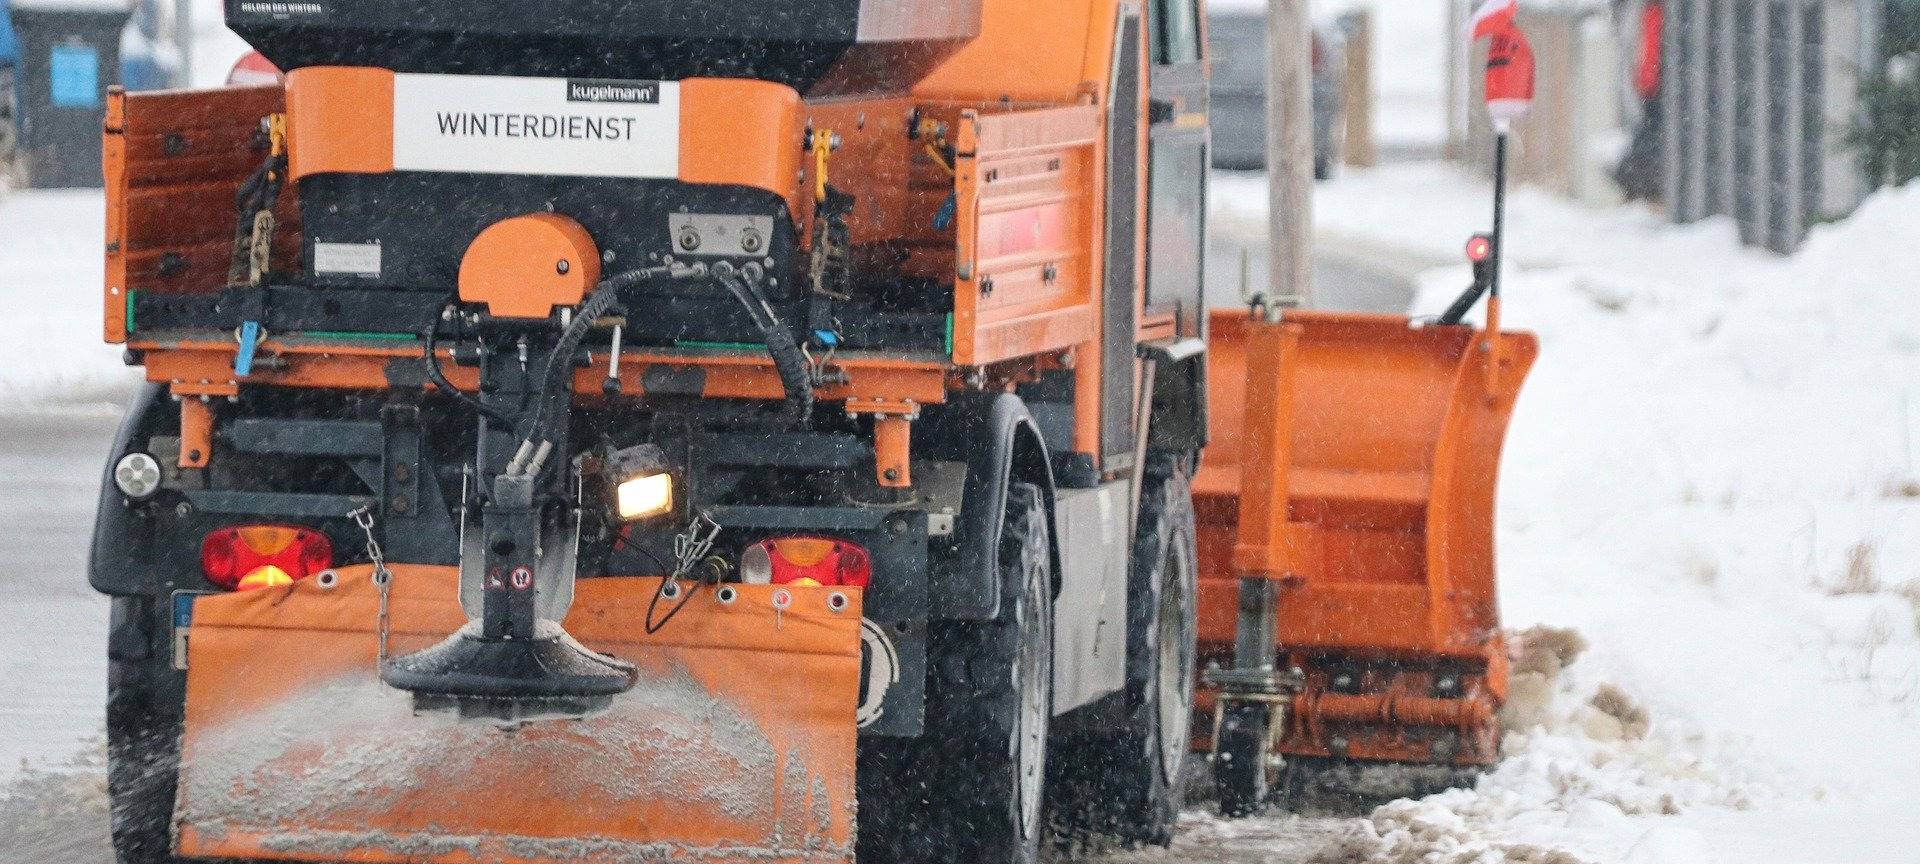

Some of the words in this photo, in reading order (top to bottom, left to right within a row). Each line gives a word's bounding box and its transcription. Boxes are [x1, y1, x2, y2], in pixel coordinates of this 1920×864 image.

[241, 2, 272, 12] HELDEN
[272, 2, 287, 12] DES
[287, 3, 322, 13] WINTERS
[436, 111, 637, 141] WINTERDIENST
